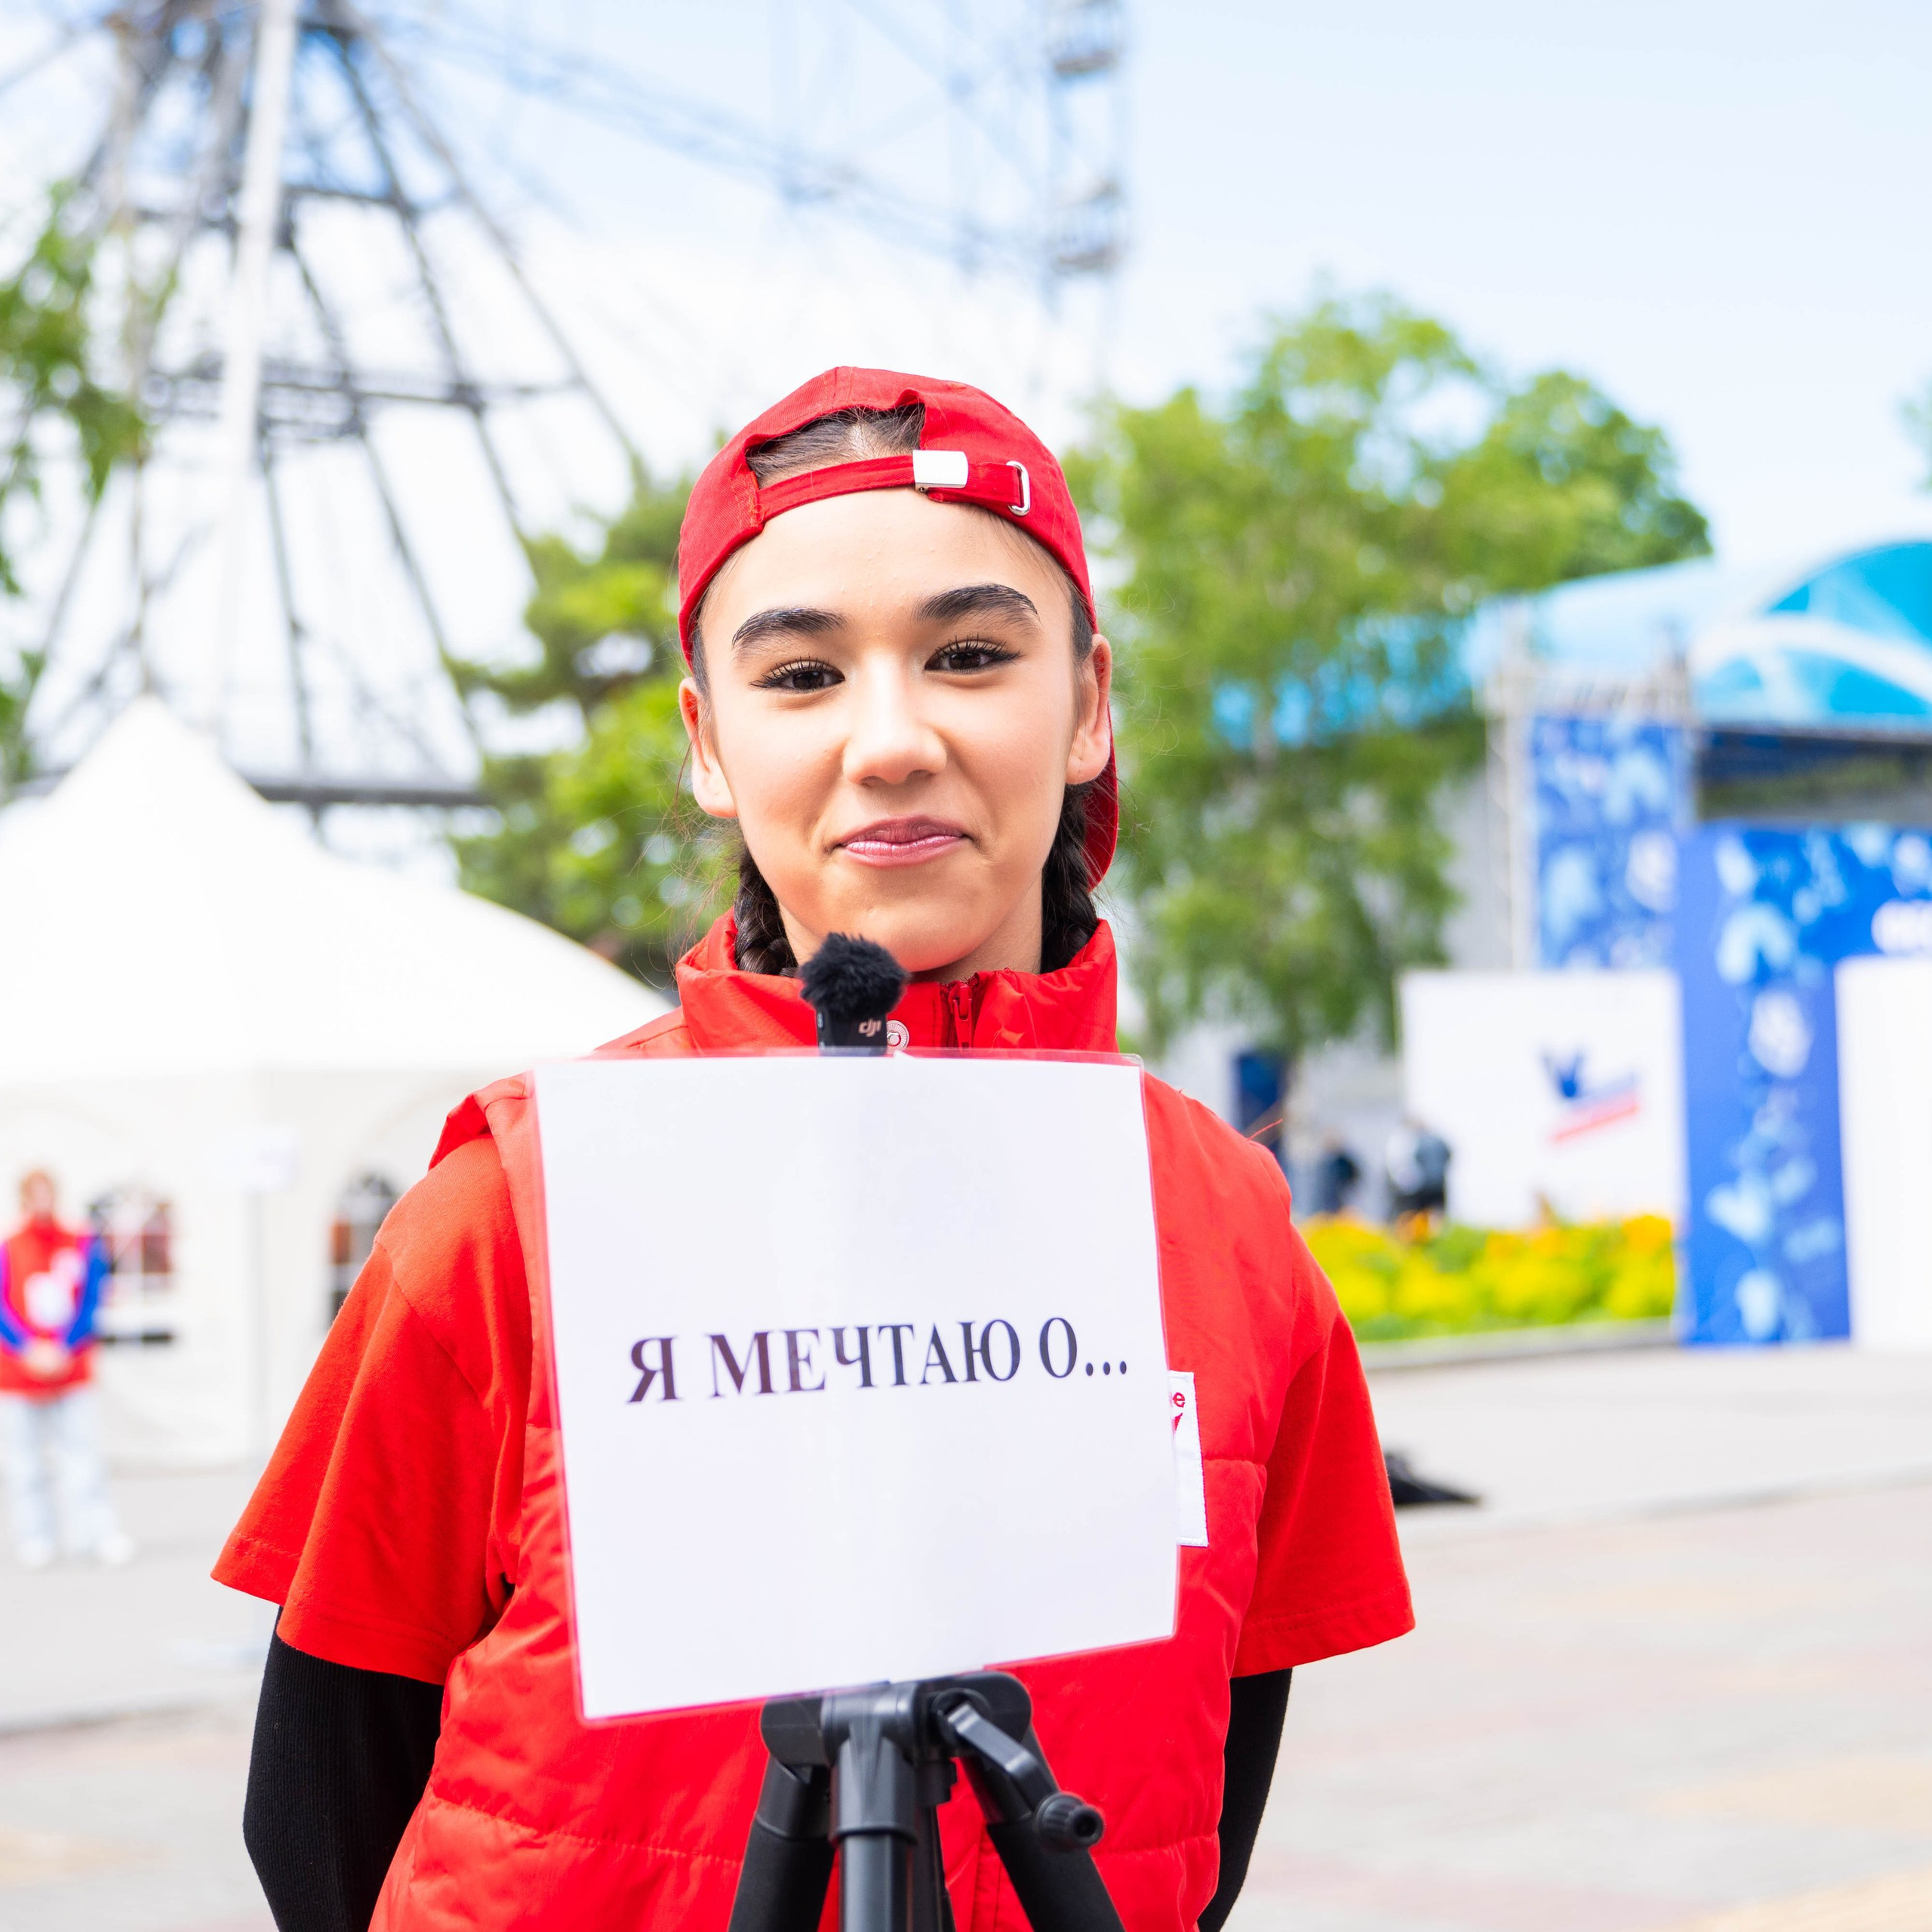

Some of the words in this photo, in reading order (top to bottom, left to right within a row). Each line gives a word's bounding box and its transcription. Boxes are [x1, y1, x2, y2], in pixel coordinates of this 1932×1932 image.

[859, 1018, 882, 1037] dji
[626, 1335, 682, 1404] Я
[706, 1318, 1022, 1398] МЕЧТАЮ
[1038, 1317, 1128, 1379] О...
